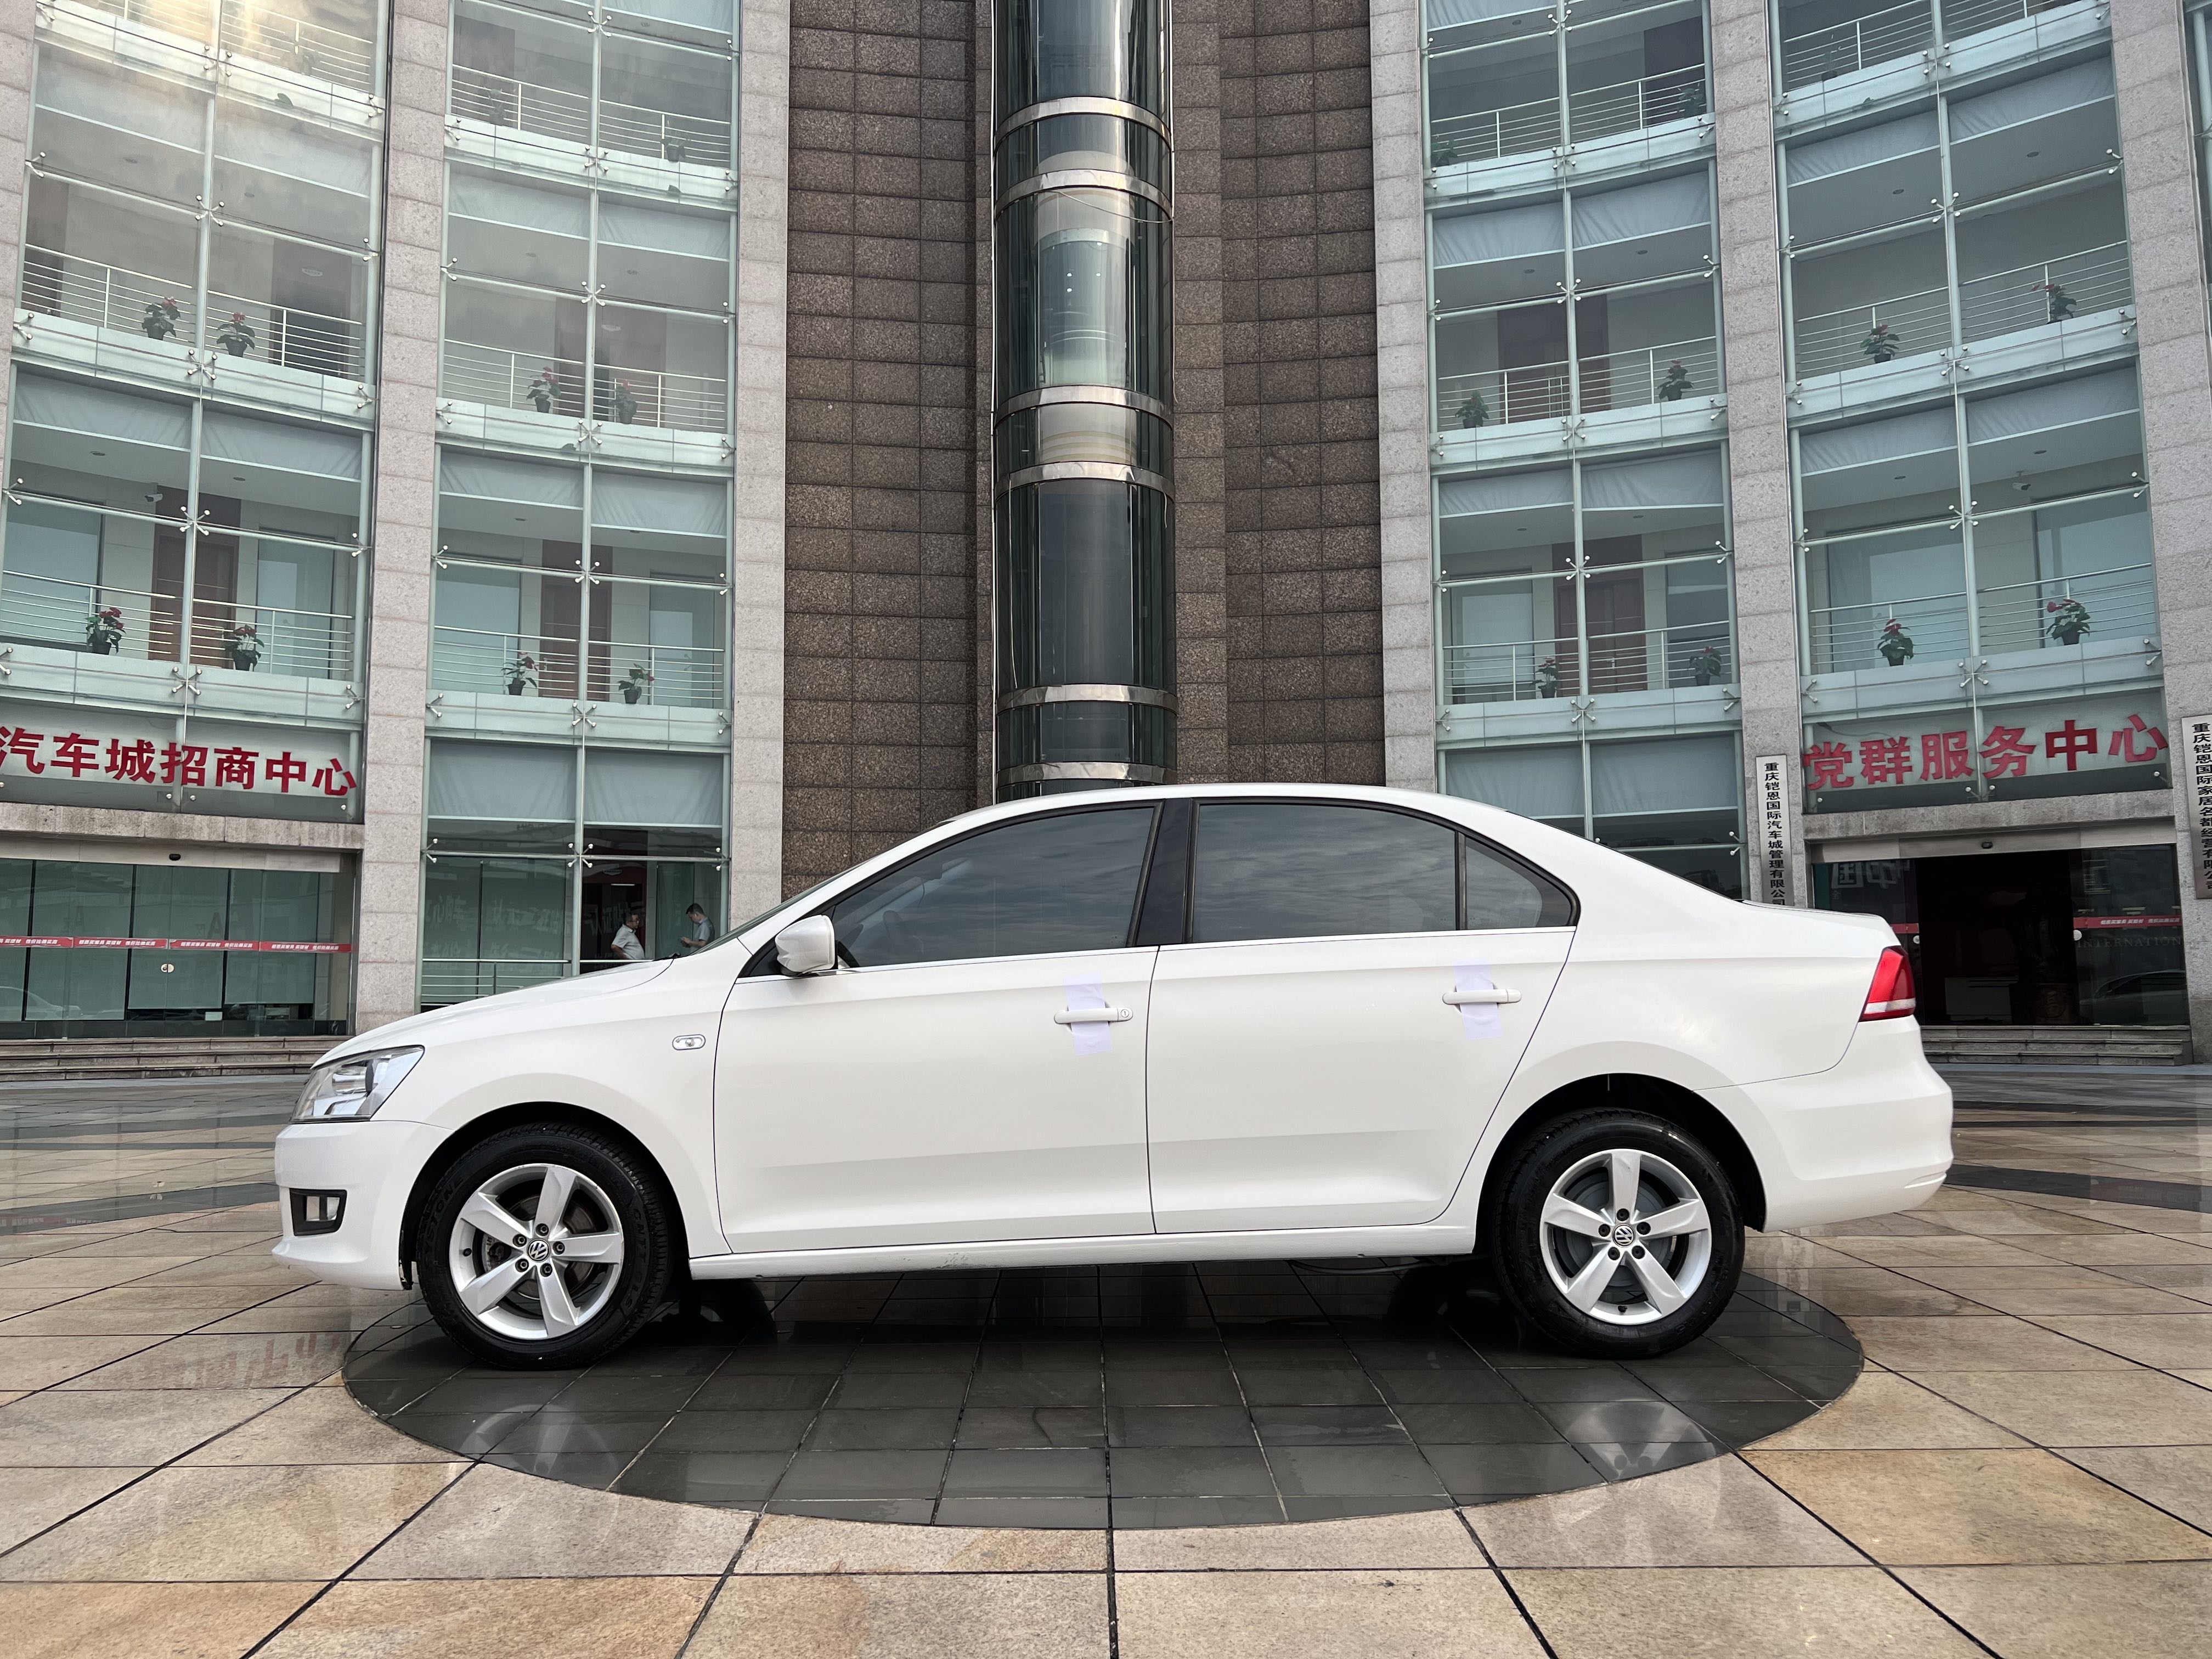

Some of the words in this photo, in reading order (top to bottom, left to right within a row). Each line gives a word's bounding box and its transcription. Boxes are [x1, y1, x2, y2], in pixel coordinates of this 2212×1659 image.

[0, 726, 357, 796] 汽车城招商中心
[1803, 714, 2168, 790] 党群服务中心
[1765, 762, 1785, 905] 重庆铠恩国际汽车城管理有限公司
